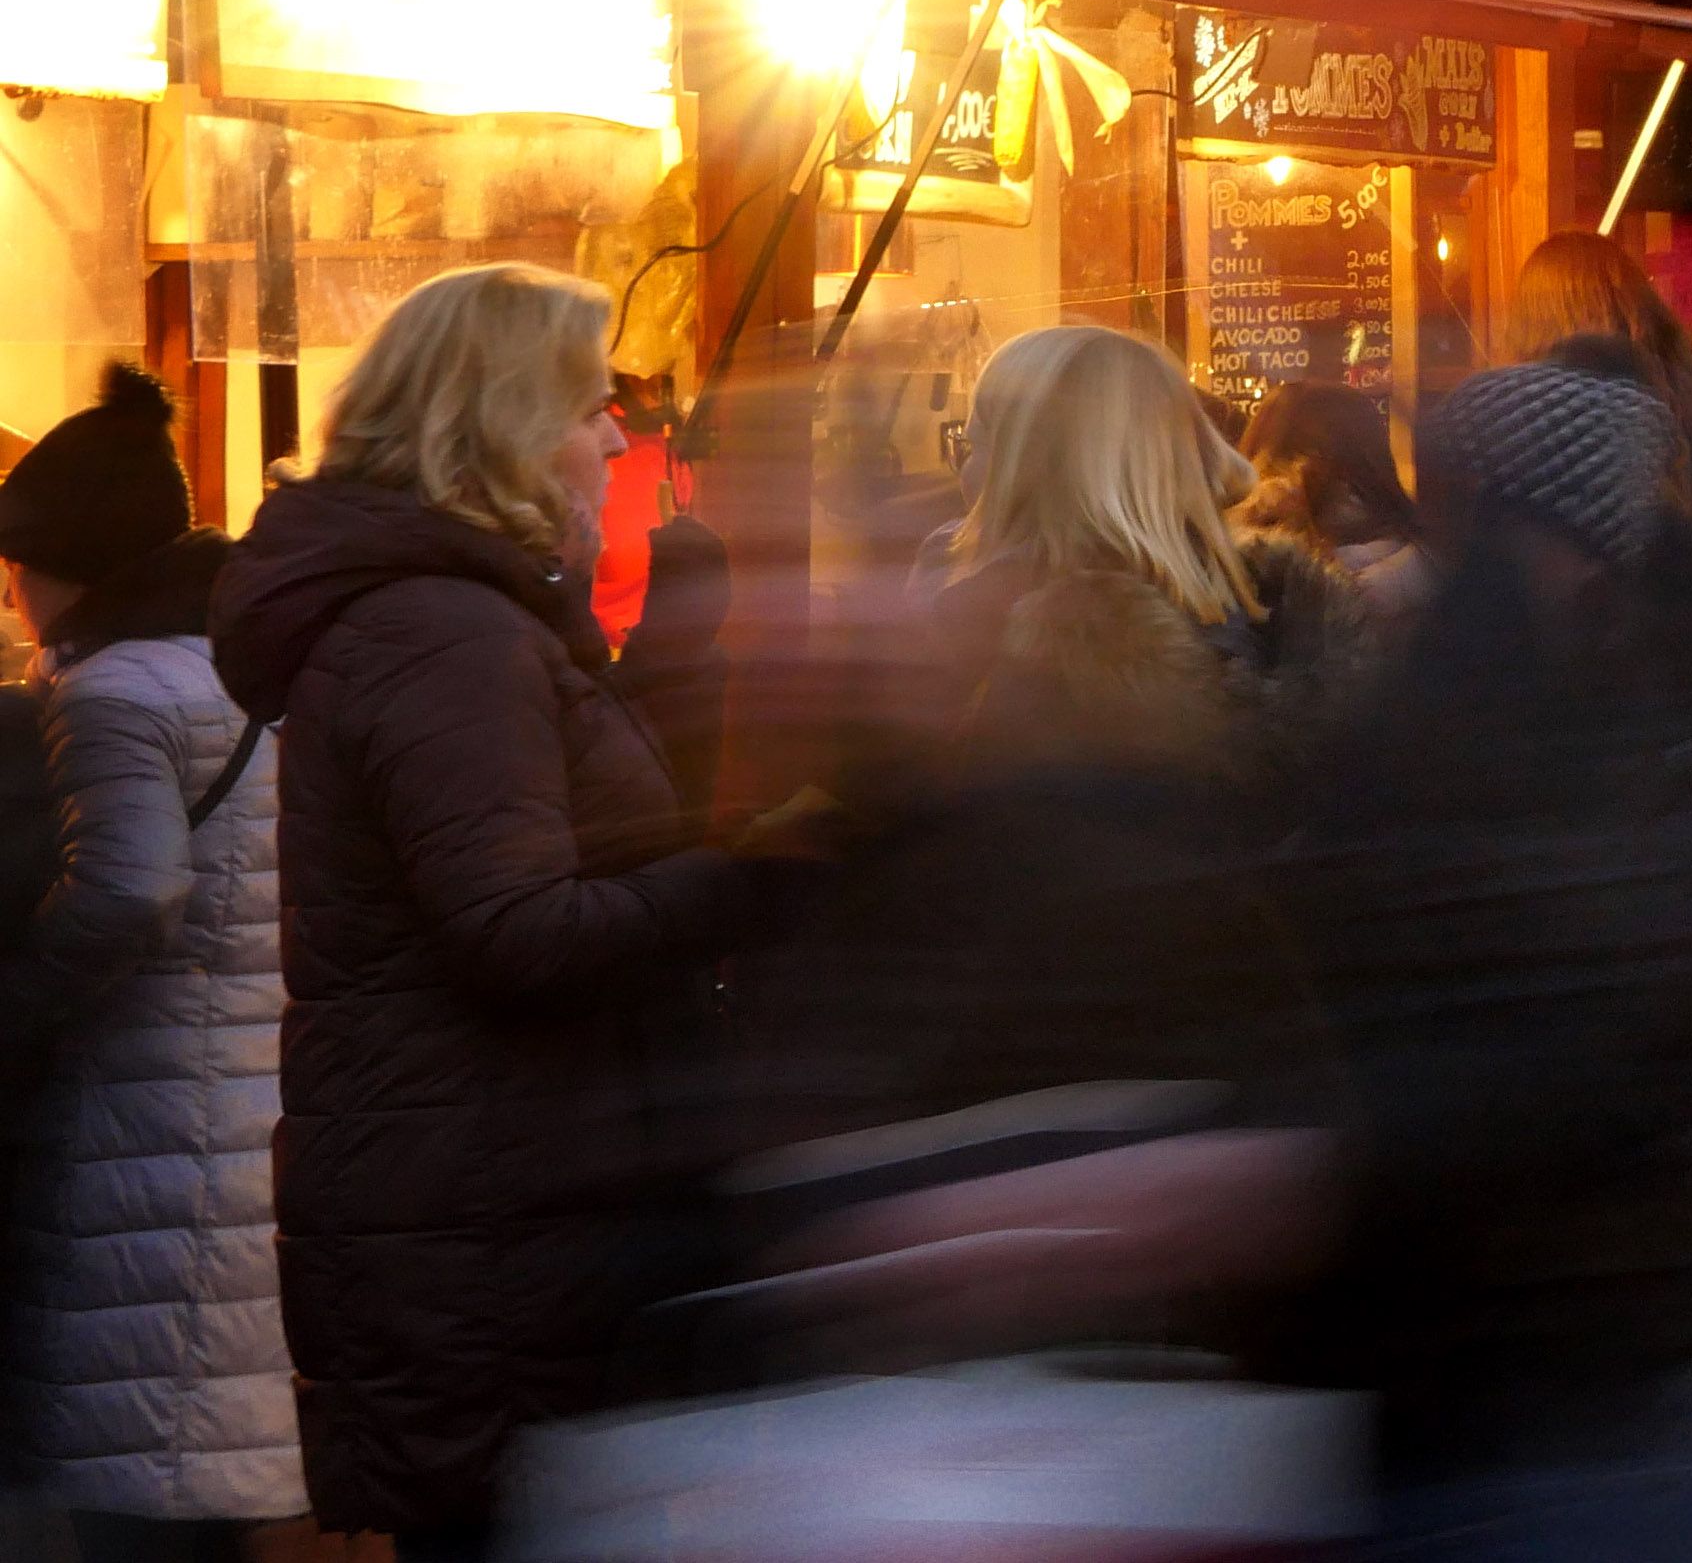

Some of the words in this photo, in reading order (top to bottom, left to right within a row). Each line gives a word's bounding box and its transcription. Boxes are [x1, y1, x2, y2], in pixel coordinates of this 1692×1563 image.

[1211, 179, 1333, 230] POMMES
[1211, 257, 1262, 275] CHILI
[1210, 279, 1283, 300] CHEESE
[1212, 326, 1302, 348] AVOCADO
[1213, 351, 1252, 373] HOT
[1258, 348, 1311, 371] TACO
